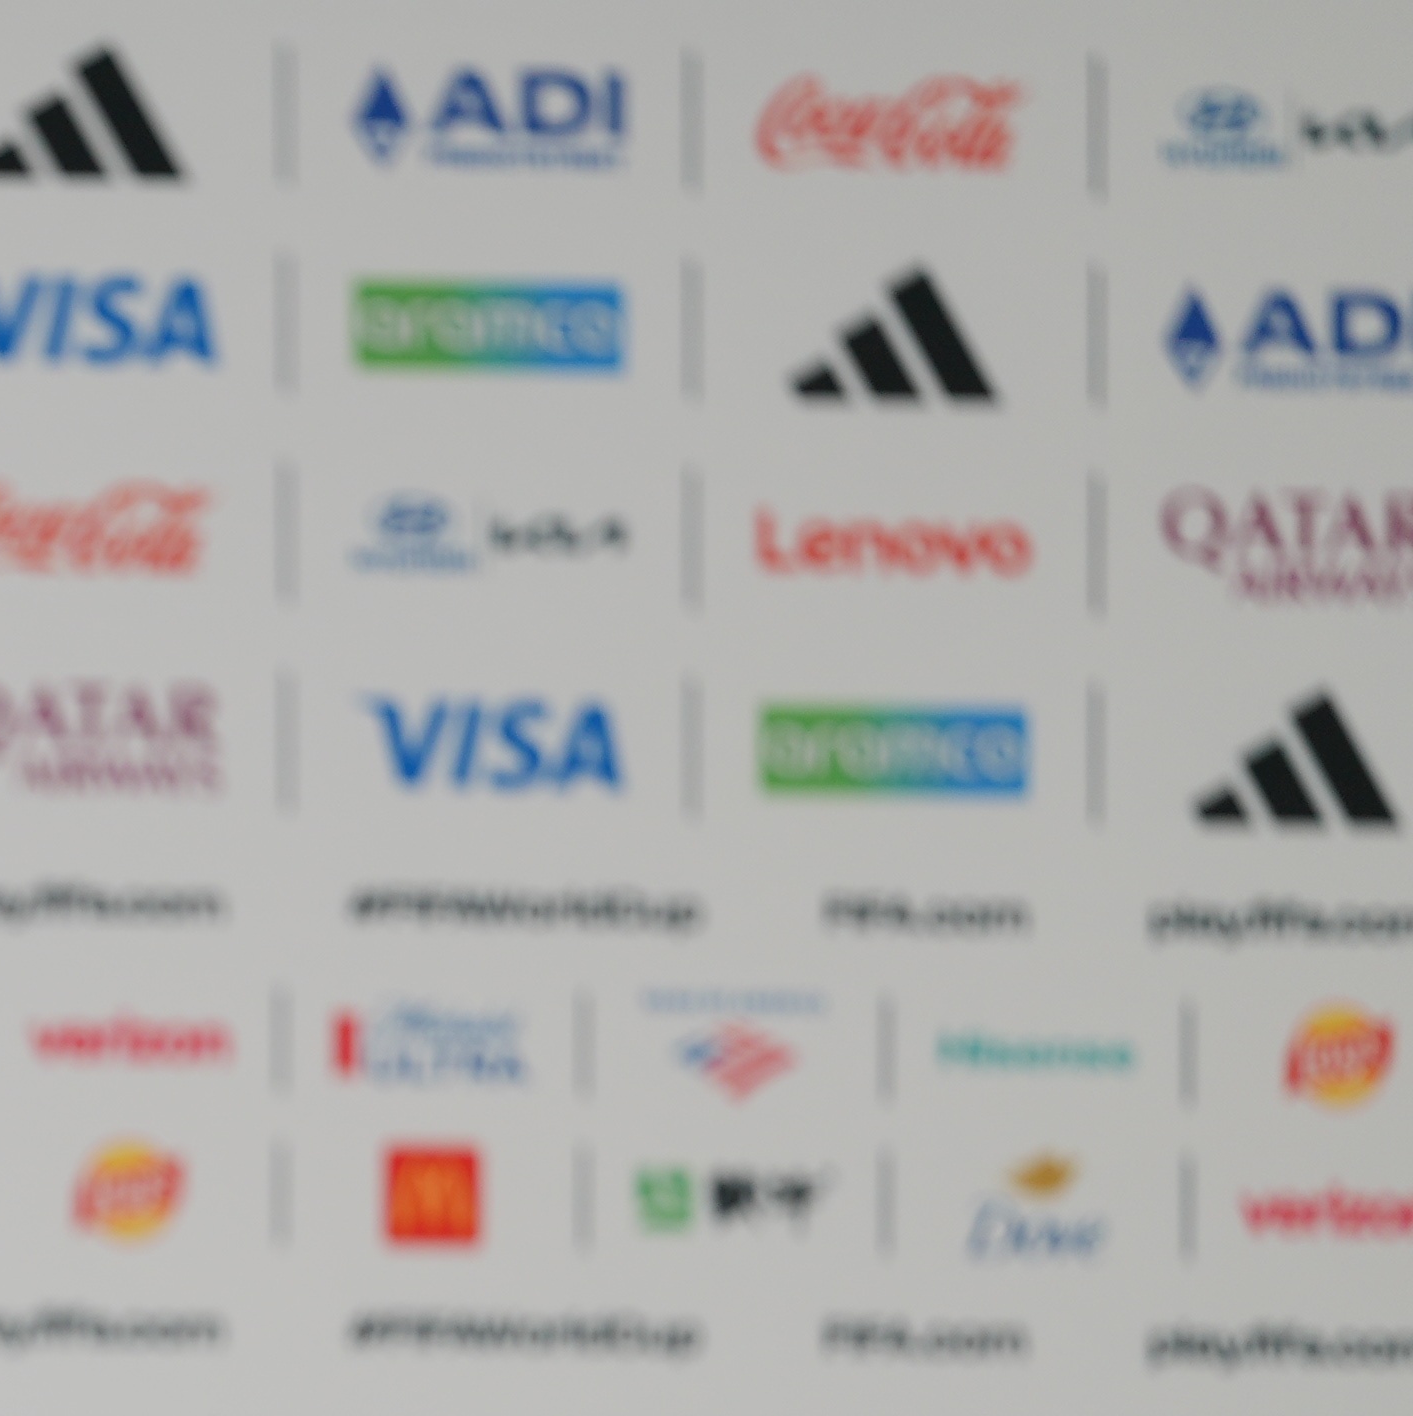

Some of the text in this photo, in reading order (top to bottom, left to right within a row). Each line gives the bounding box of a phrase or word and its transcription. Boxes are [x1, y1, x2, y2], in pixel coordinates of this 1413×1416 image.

[429, 67, 627, 134] ADI
[1241, 289, 1413, 356] AD
[755, 511, 1033, 577] Lenovo
[1159, 490, 1413, 569] QATAR
[372, 698, 623, 792] VISA
